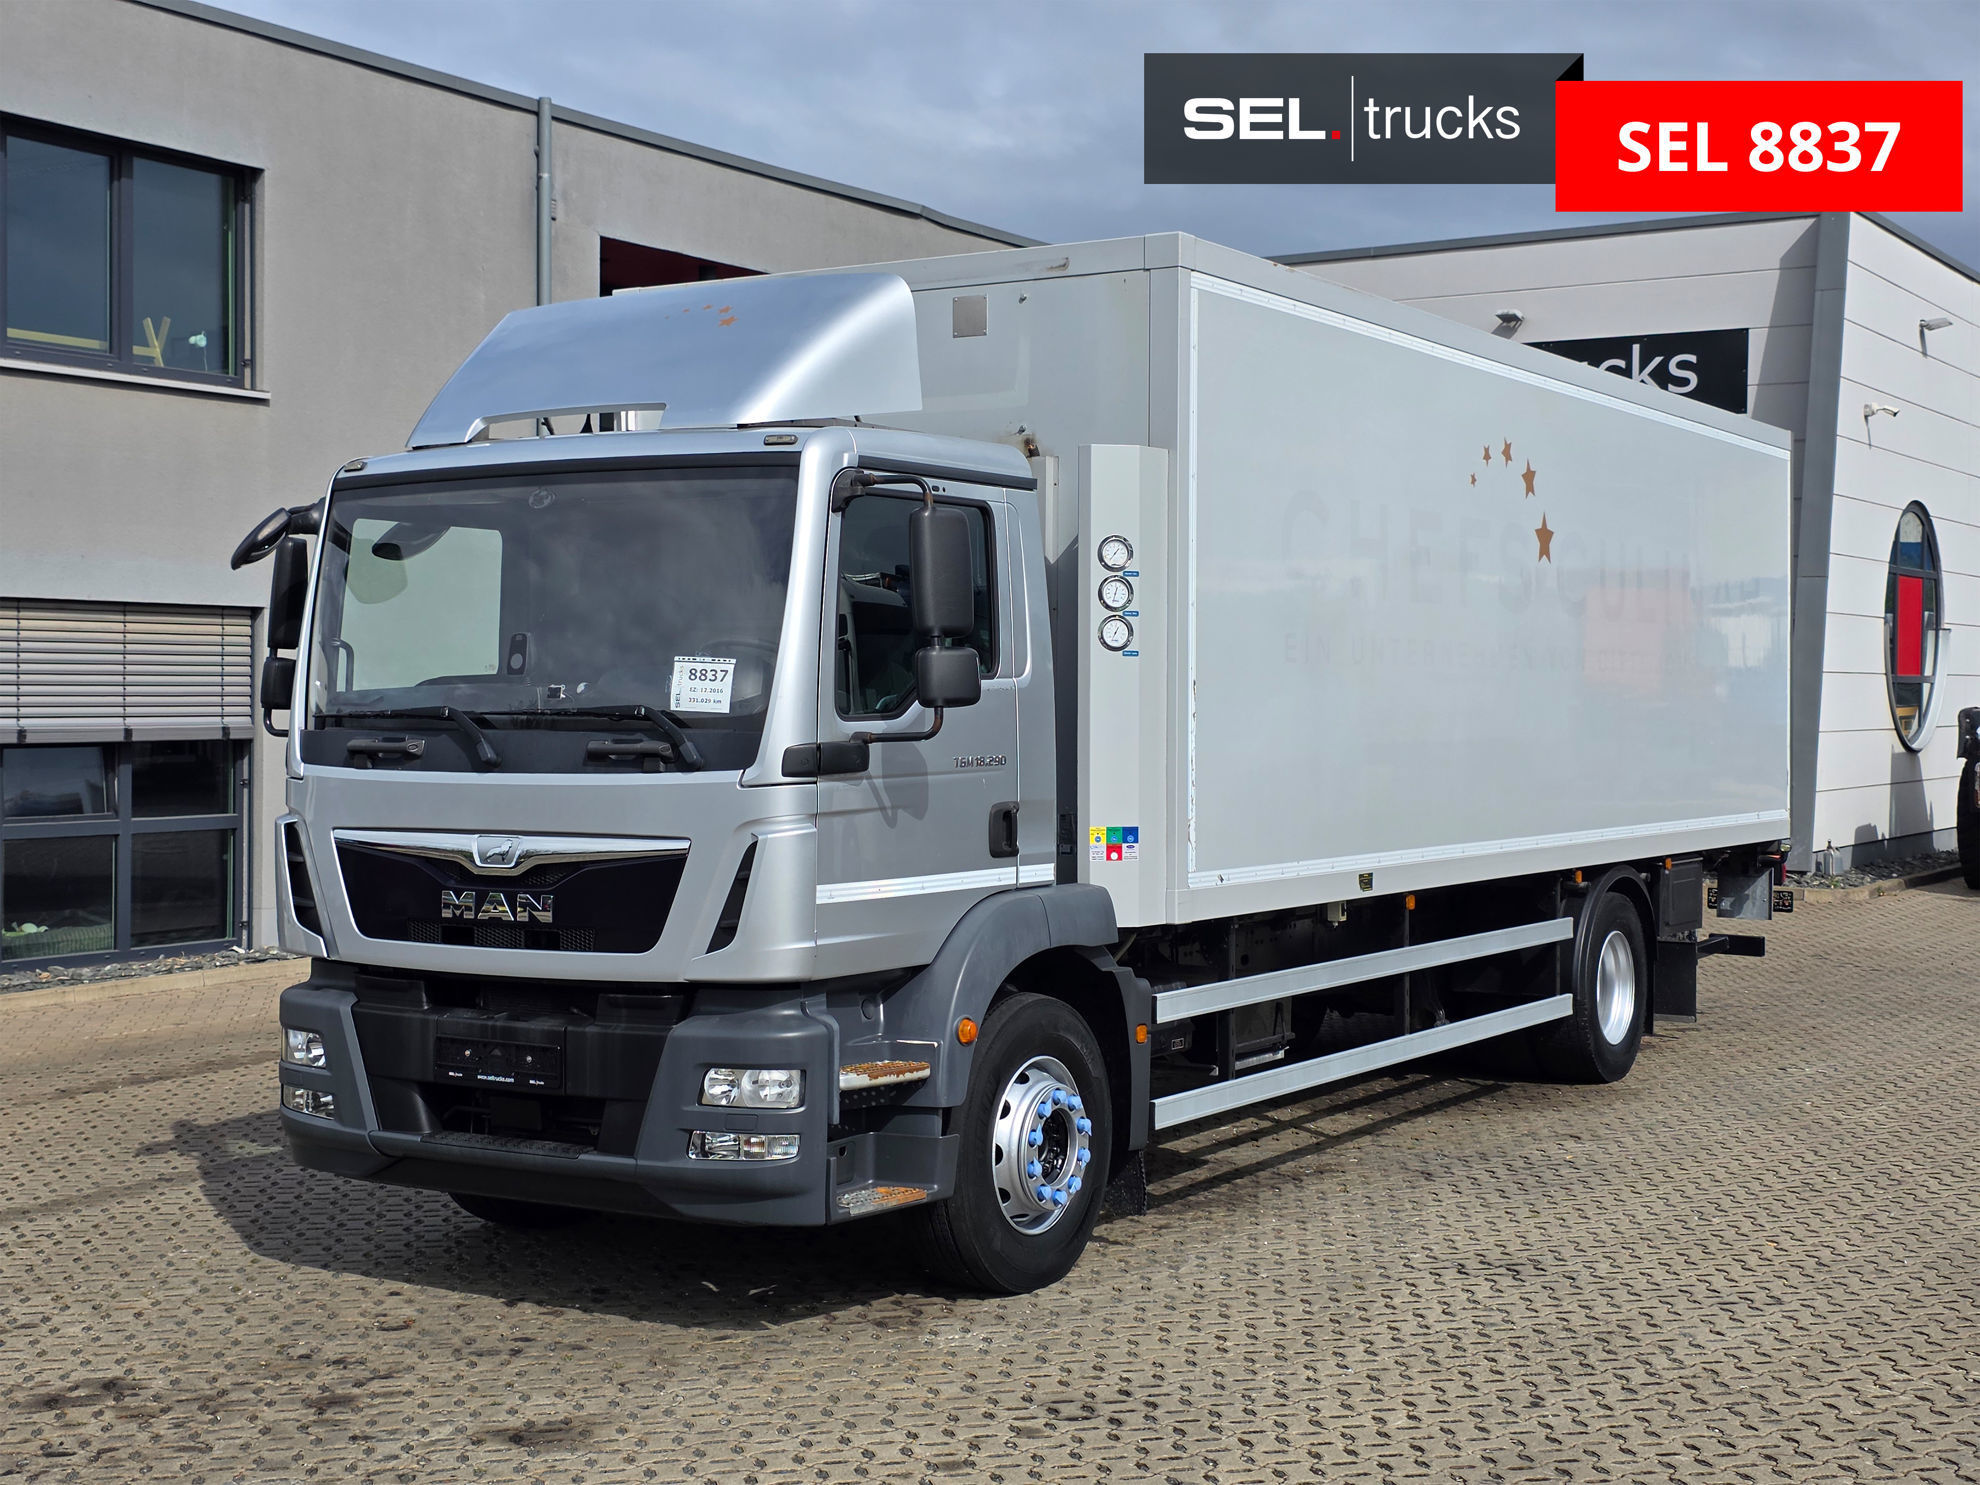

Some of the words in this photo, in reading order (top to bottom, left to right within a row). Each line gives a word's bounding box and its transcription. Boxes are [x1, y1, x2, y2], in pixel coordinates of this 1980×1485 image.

[688, 668, 729, 683] 8837
[975, 754, 1007, 767] 18.290
[441, 889, 554, 924] MAN
